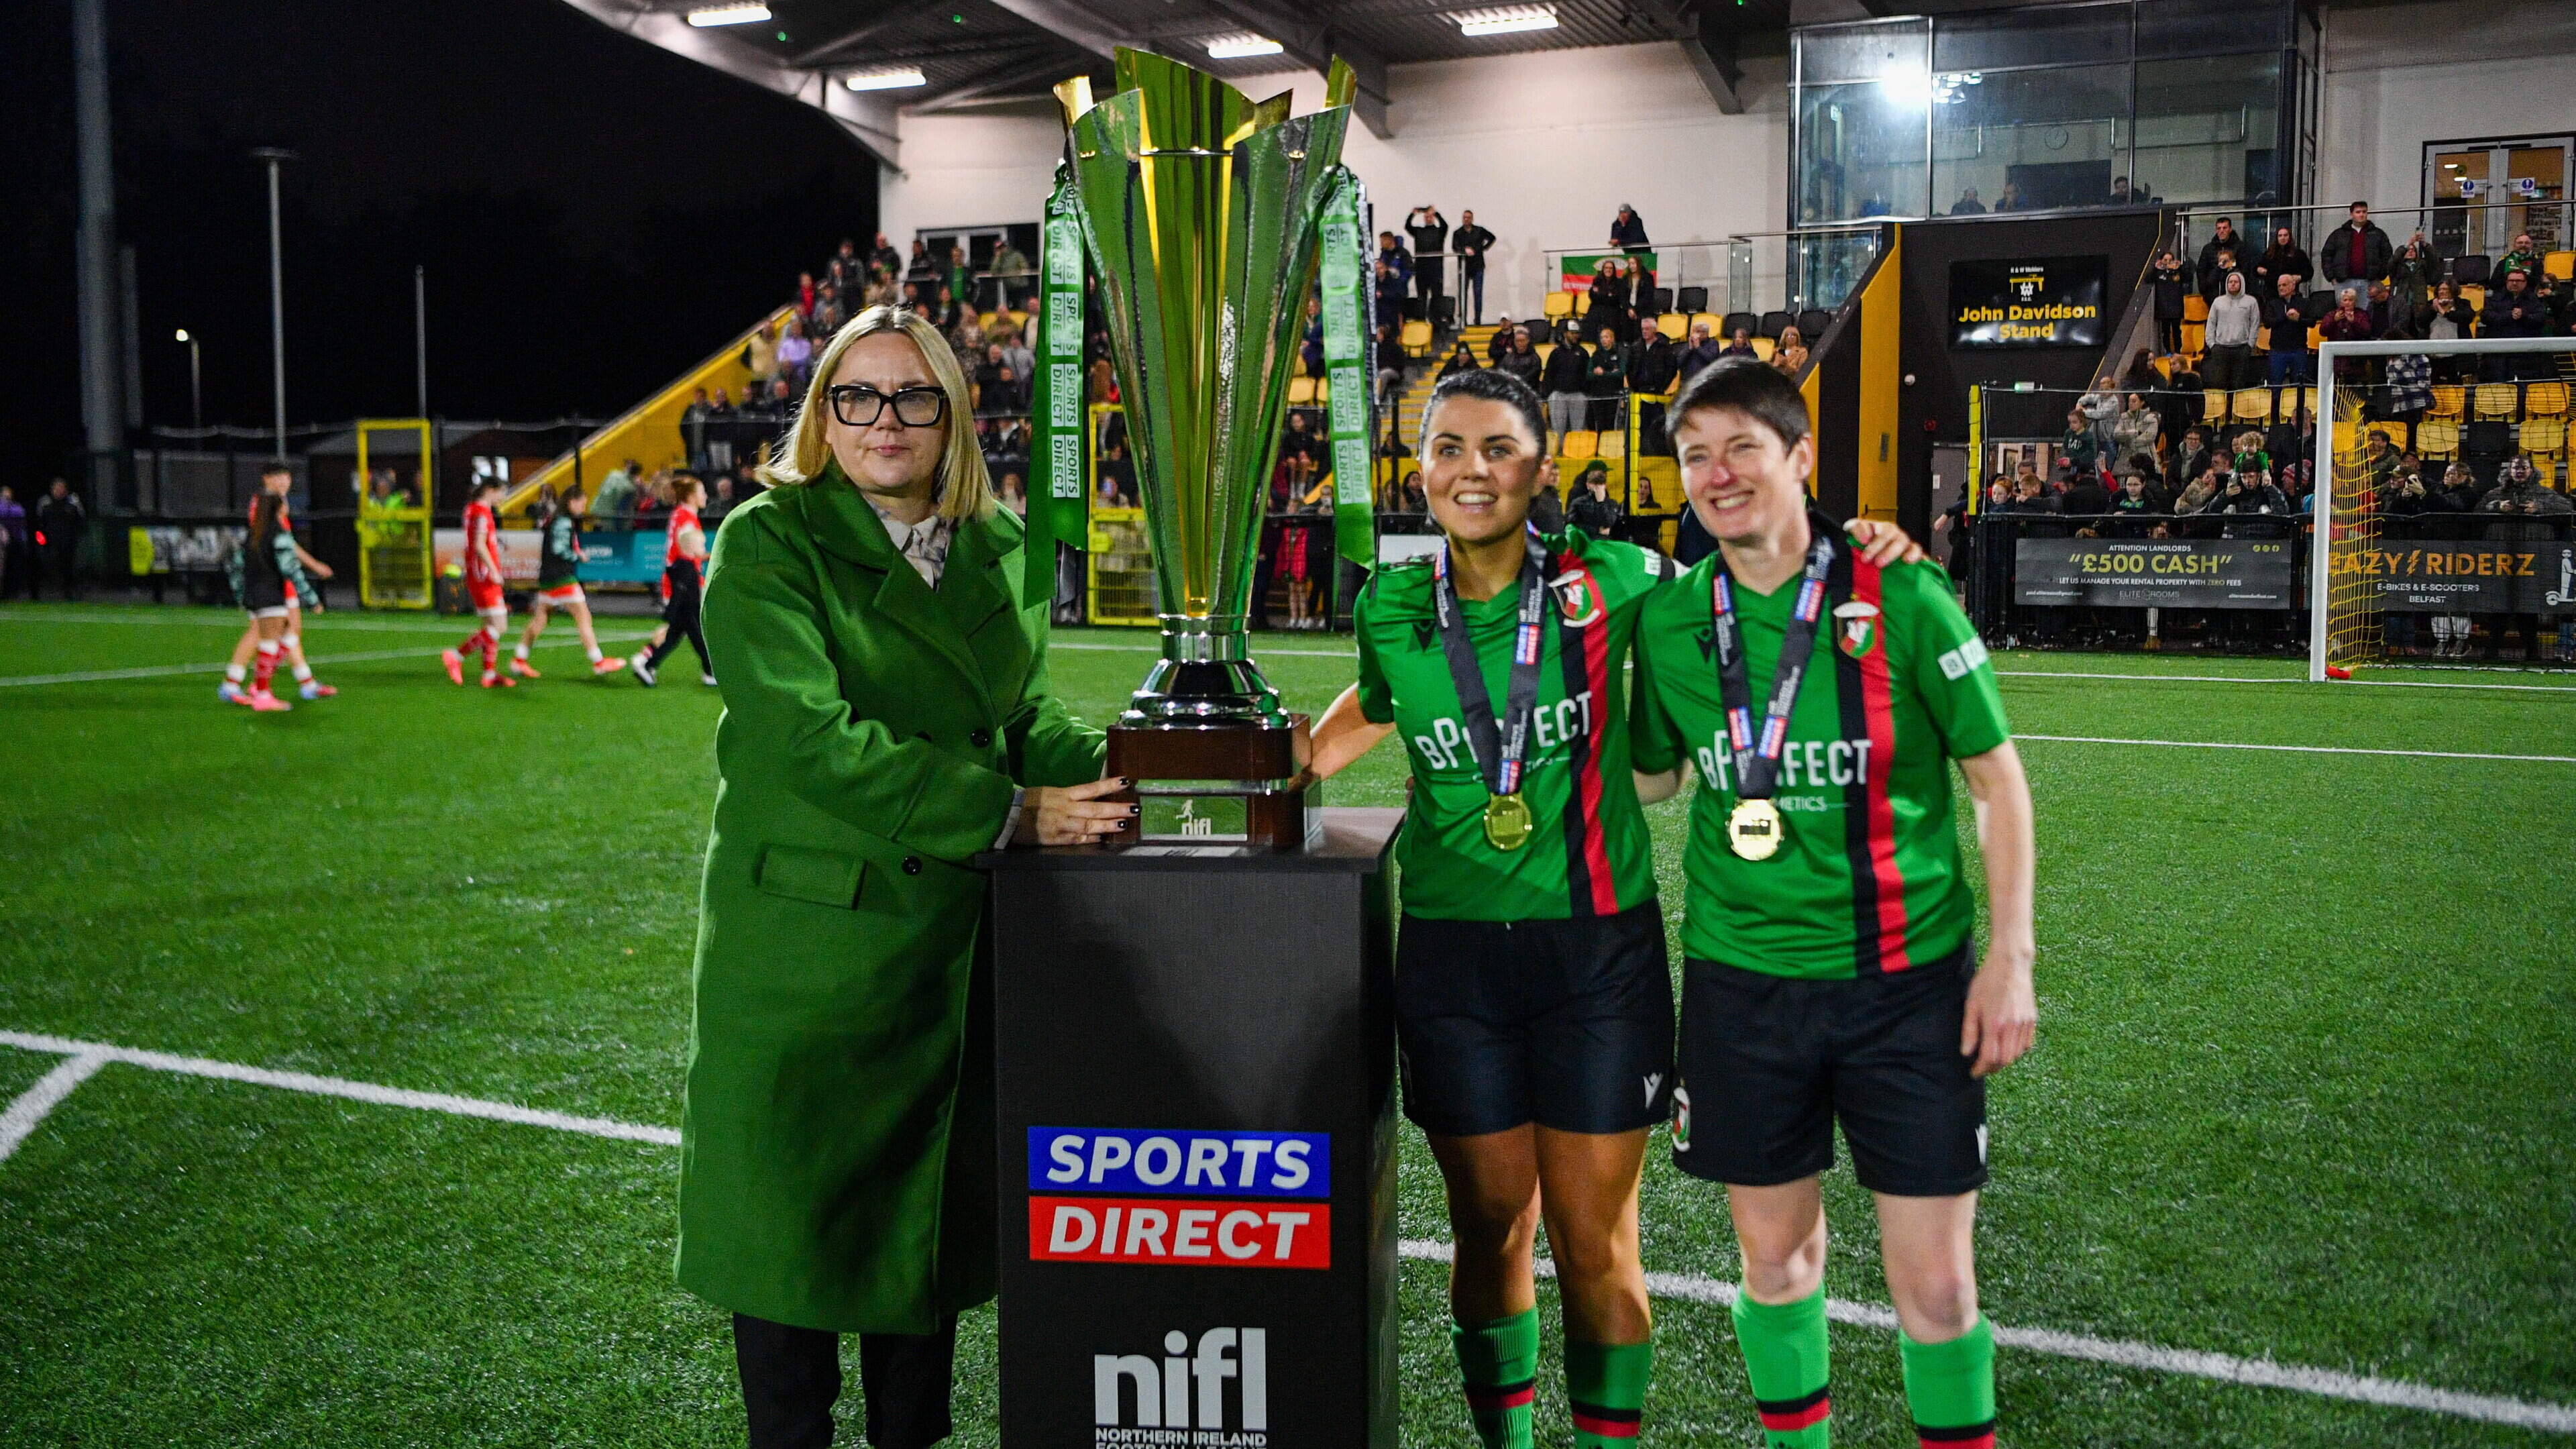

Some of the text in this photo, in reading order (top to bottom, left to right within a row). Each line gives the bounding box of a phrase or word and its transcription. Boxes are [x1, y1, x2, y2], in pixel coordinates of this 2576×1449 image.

[1067, 225, 1077, 280] SPOTS
[1066, 298, 1076, 351] SPOS
[1958, 303, 2096, 323] John Davidson
[1999, 322, 2055, 339] Stand
[1053, 368, 1063, 422] DIRECT
[1067, 368, 1076, 423] SPORTS
[1335, 372, 1345, 427] SPORTS
[1349, 372, 1360, 427] DIRECT
[1054, 439, 1064, 493] DIRECT
[1067, 440, 1077, 494] SPORTS
[1340, 445, 1350, 499] SPORTS
[1354, 445, 1365, 498] DIRECT
[2108, 544, 2192, 553] ATTENTION LANDLORDS
[2328, 551, 2535, 576] EAZY RIDERZ
[2377, 582, 2480, 593] E-BIKES & E-SCOOTERS
[2409, 594, 2446, 604] BELFAST
[1415, 690, 1593, 769] BPECT
[1697, 730, 1872, 792] BPFECT
[1181, 817, 1212, 836] nifl
[1778, 796, 1827, 812] METICS
[1046, 1134, 1311, 1189] SPORTS
[1048, 1205, 1310, 1260] DIRECT
[1093, 1326, 1267, 1430] nifl
[1095, 1427, 1267, 1447] NORTHERN IRELAND
